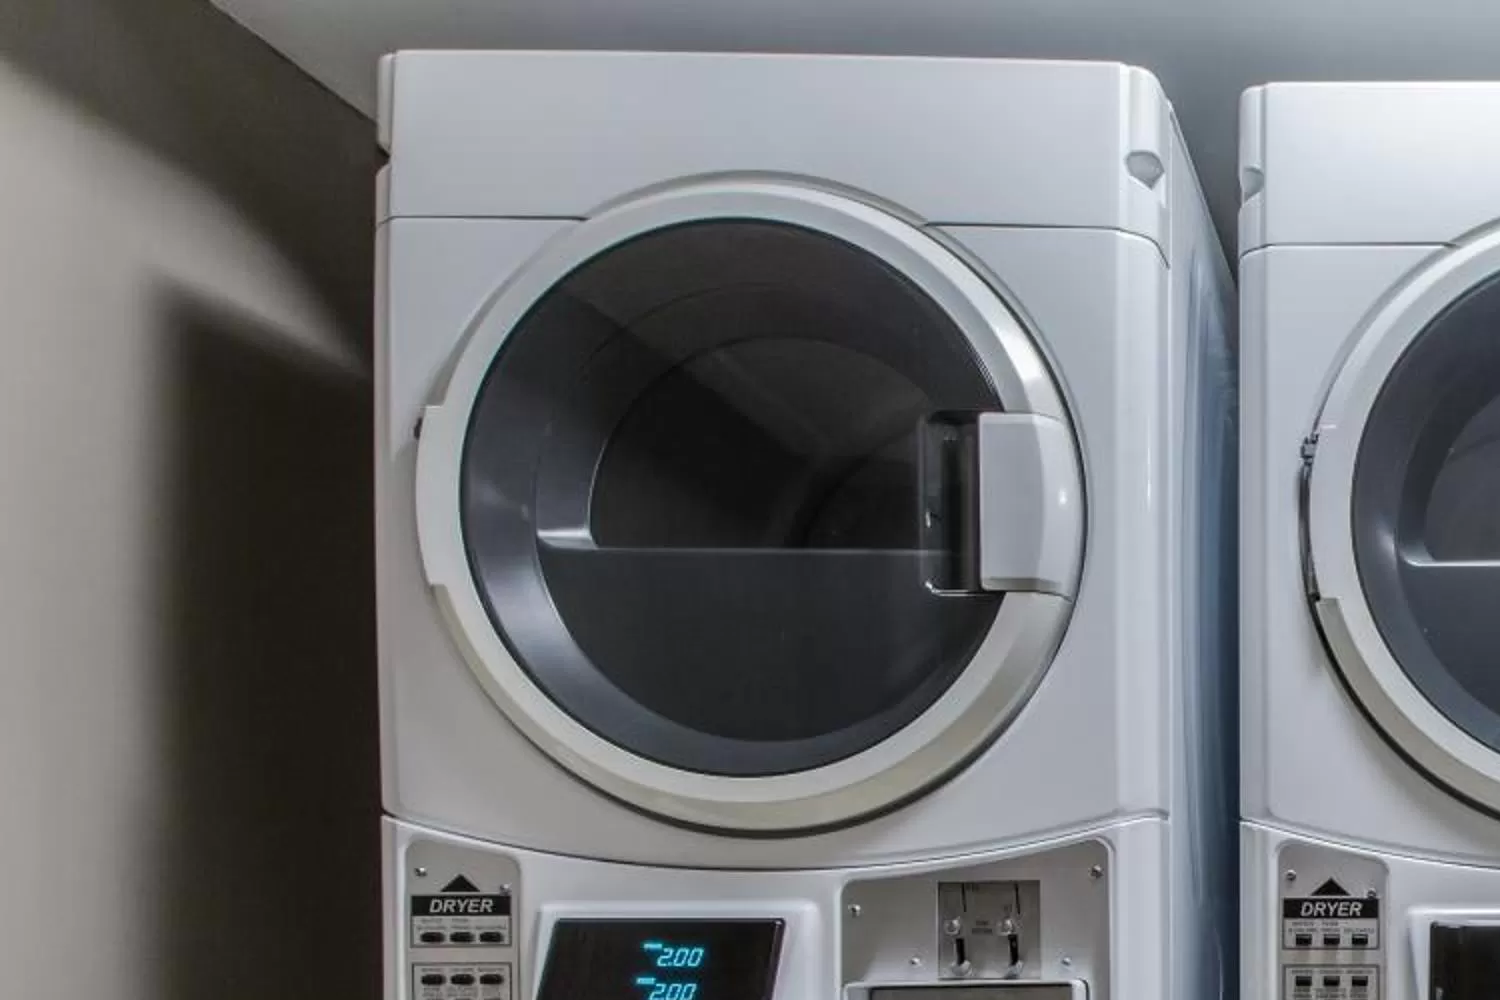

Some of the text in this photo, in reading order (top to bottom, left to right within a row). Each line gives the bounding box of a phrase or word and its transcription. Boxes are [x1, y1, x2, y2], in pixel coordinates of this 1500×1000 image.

[429, 898, 494, 913] DRYER
[1300, 901, 1363, 917] DRYER
[656, 947, 705, 967] 2.00
